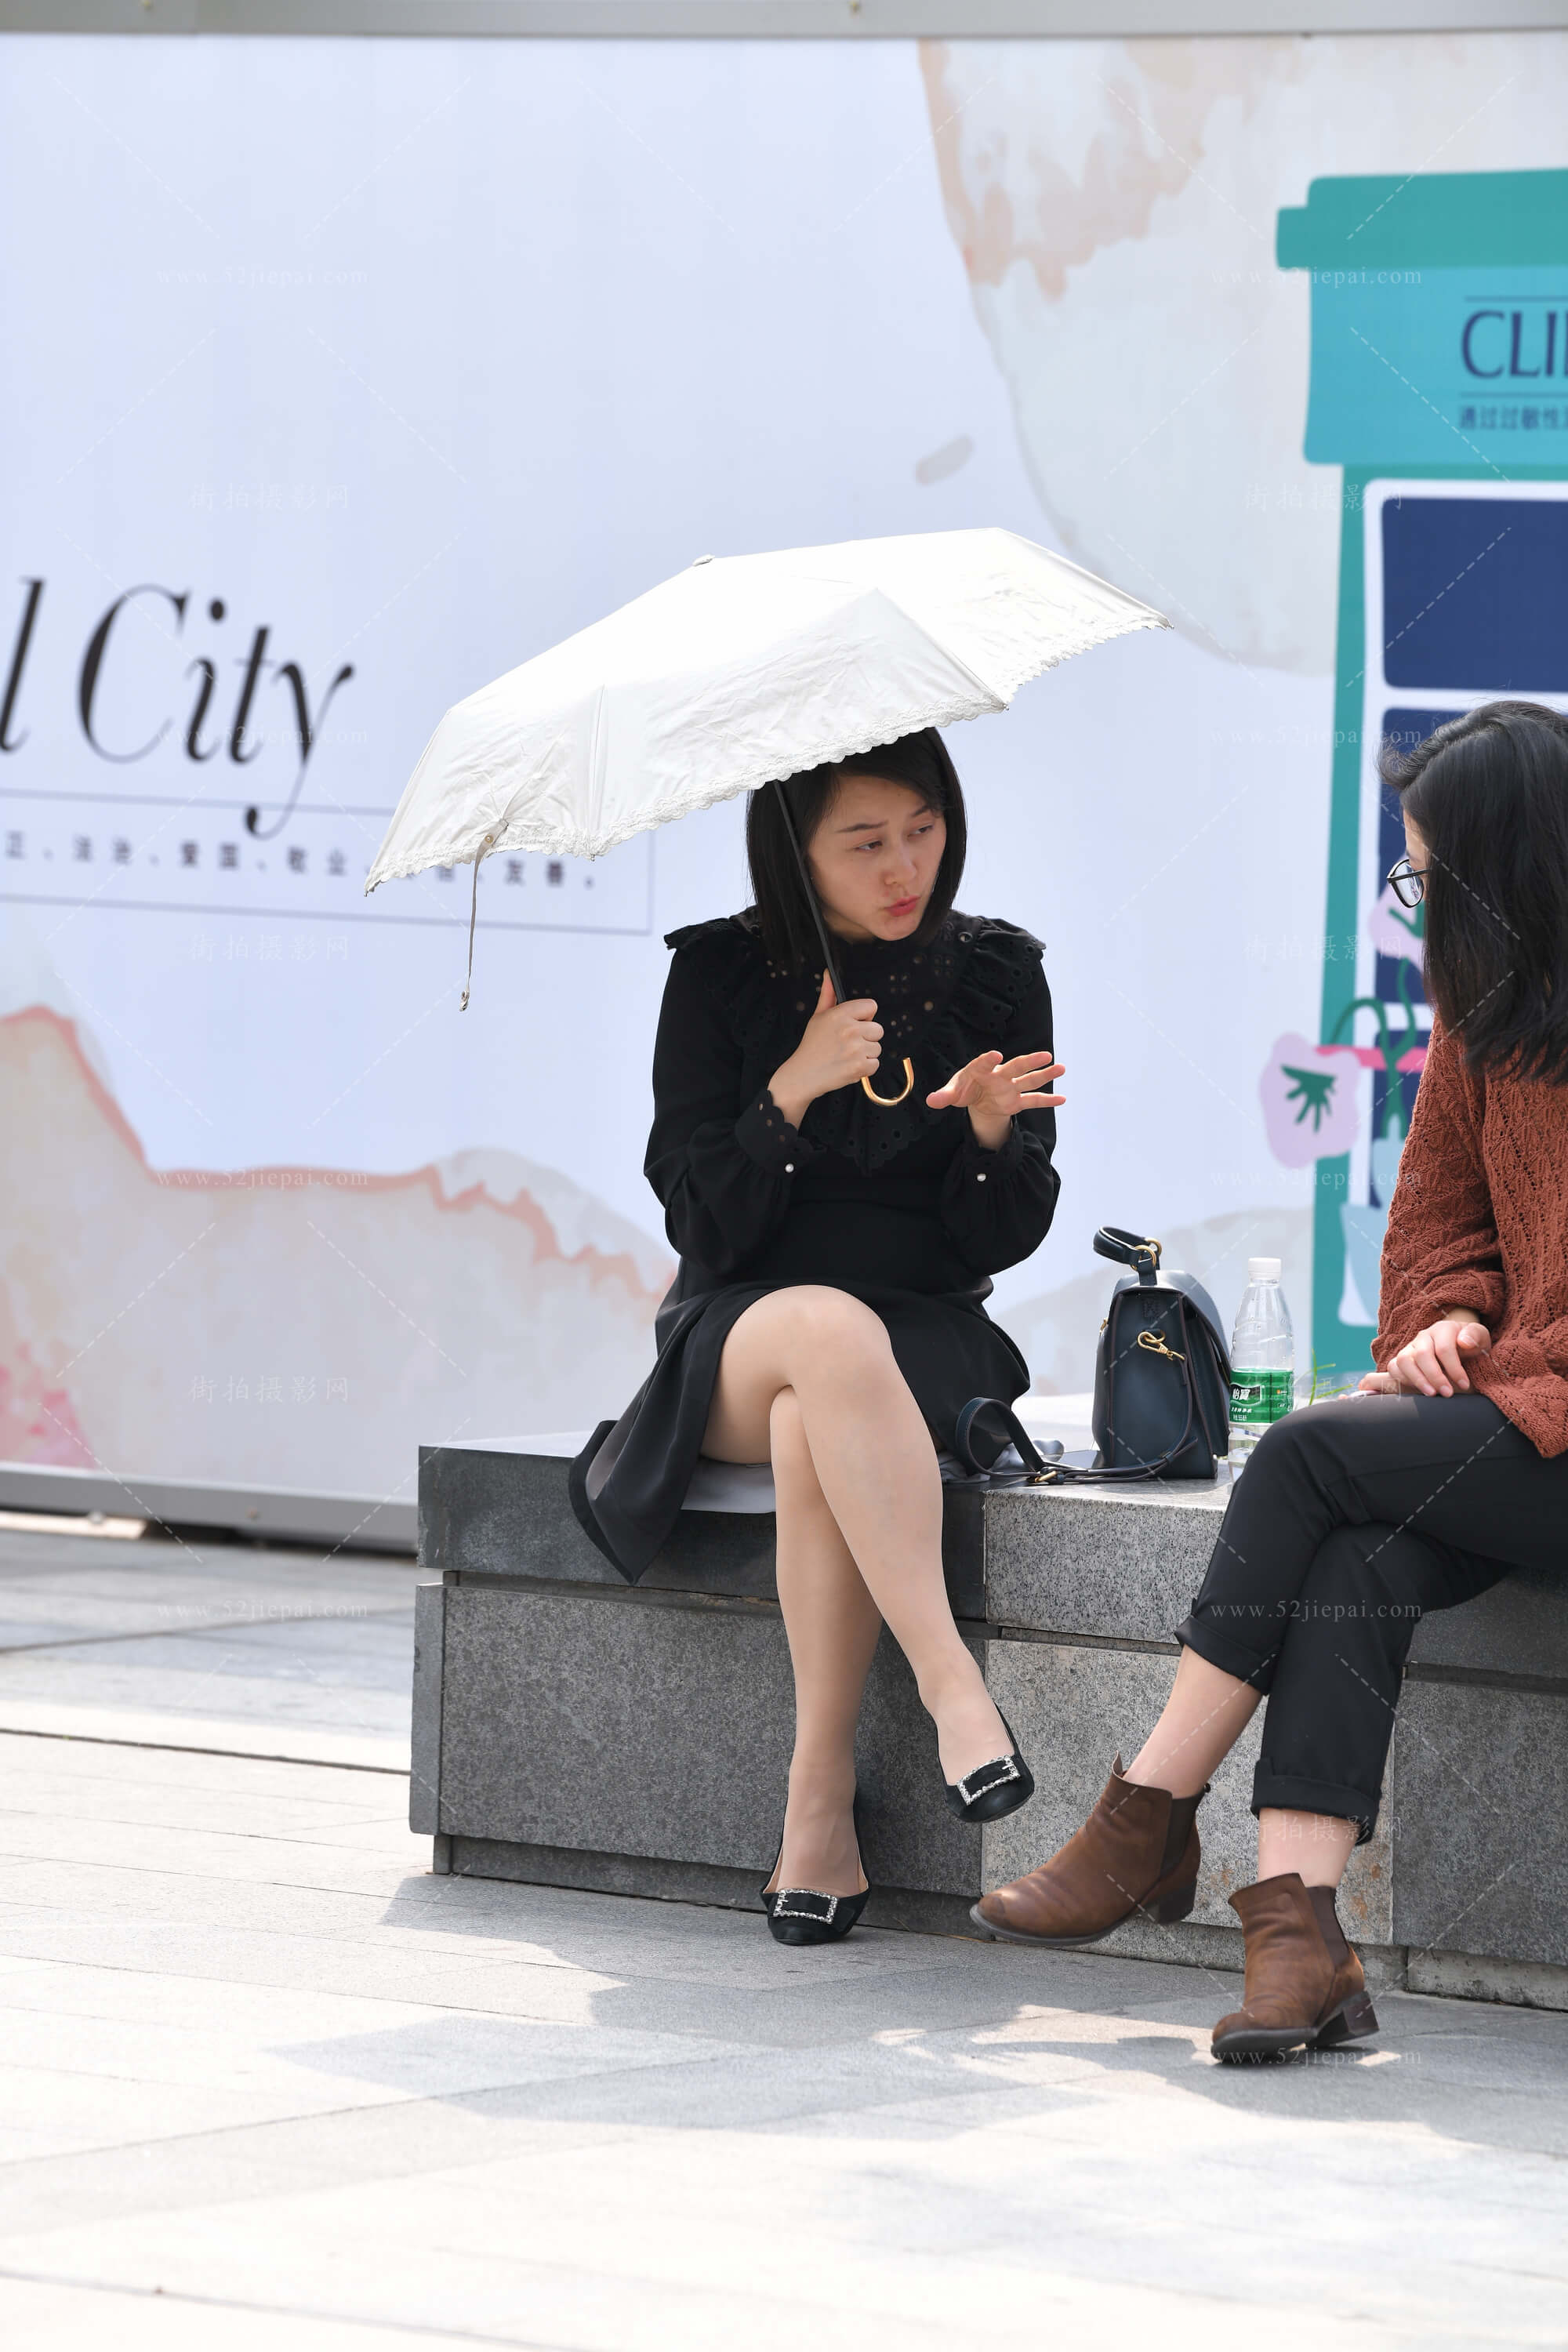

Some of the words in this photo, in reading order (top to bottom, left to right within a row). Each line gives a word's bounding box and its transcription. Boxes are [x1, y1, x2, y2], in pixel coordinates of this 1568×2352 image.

[1461, 309, 1568, 379] CLI
[1460, 405, 1568, 430] 通过过敏性
[76, 583, 355, 842] City
